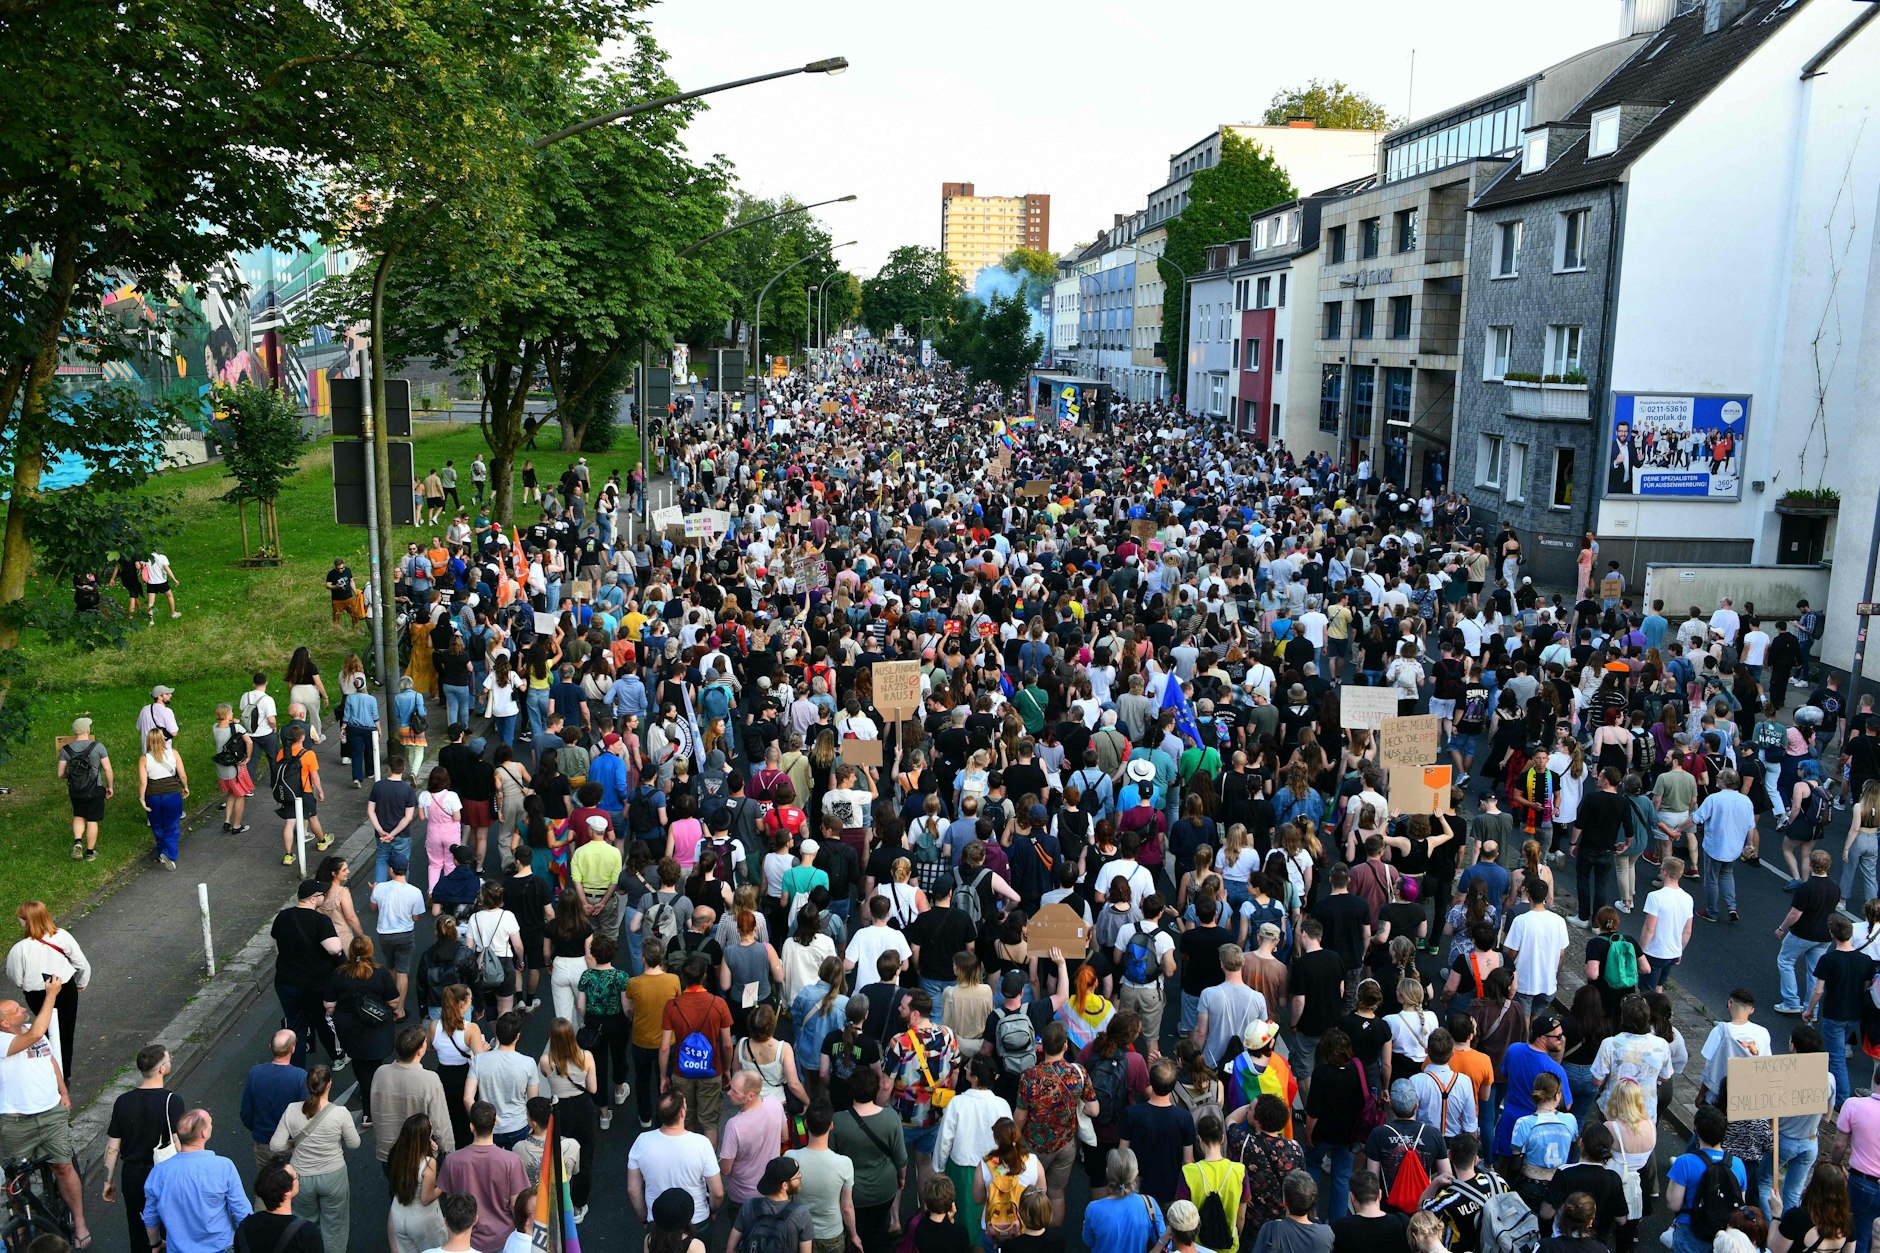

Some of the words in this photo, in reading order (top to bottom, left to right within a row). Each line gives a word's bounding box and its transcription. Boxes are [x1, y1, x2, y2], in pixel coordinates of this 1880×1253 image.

[1647, 405, 1688, 413] 0211-53610
[1645, 413, 1687, 422] moplak.de
[874, 664, 920, 676] AUSLÄNDER
[881, 682, 908, 693] NAZIS
[1466, 689, 1489, 699] SMILE
[1385, 720, 1408, 736] EENE
[1409, 718, 1435, 731] MEENE
[1406, 734, 1419, 743] DIE
[1759, 735, 1781, 745] HASS
[1384, 748, 1401, 760] MUSS
[1399, 755, 1413, 764] HEX
[1414, 754, 1429, 763] HEX
[685, 1047, 709, 1059] Stay
[684, 1060, 708, 1070] cool!
[1753, 1058, 1797, 1074] FASCISM
[1791, 1087, 1828, 1106] ENERGY
[1544, 1142, 1563, 1168] 4
